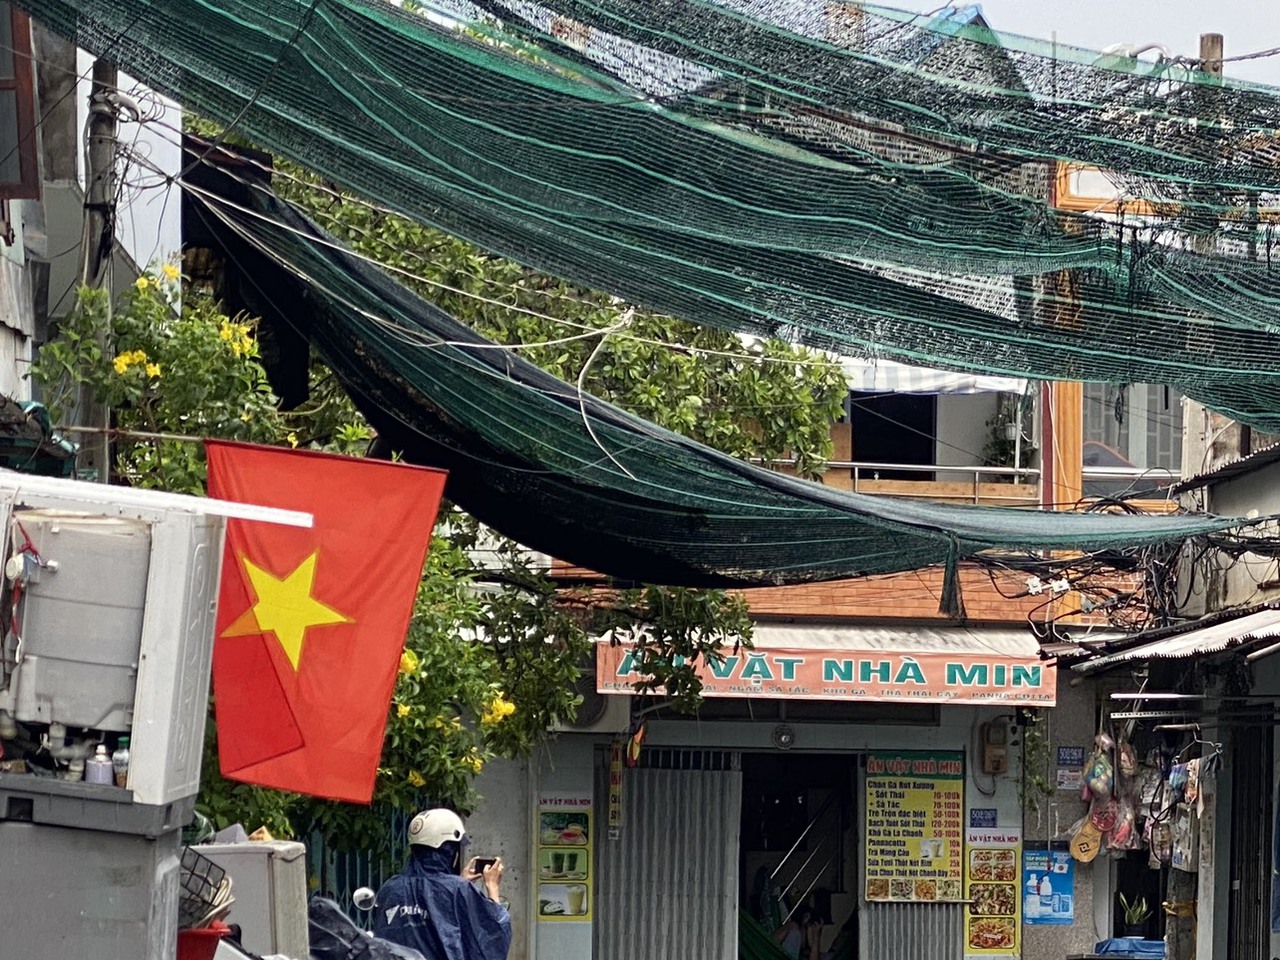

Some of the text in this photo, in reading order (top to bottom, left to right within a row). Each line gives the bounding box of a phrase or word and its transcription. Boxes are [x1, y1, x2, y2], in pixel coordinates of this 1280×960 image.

[707, 651, 805, 687] VẶT
[822, 655, 928, 684] NHÀ
[945, 662, 1043, 688] MIN
[938, 760, 962, 775] MIN
